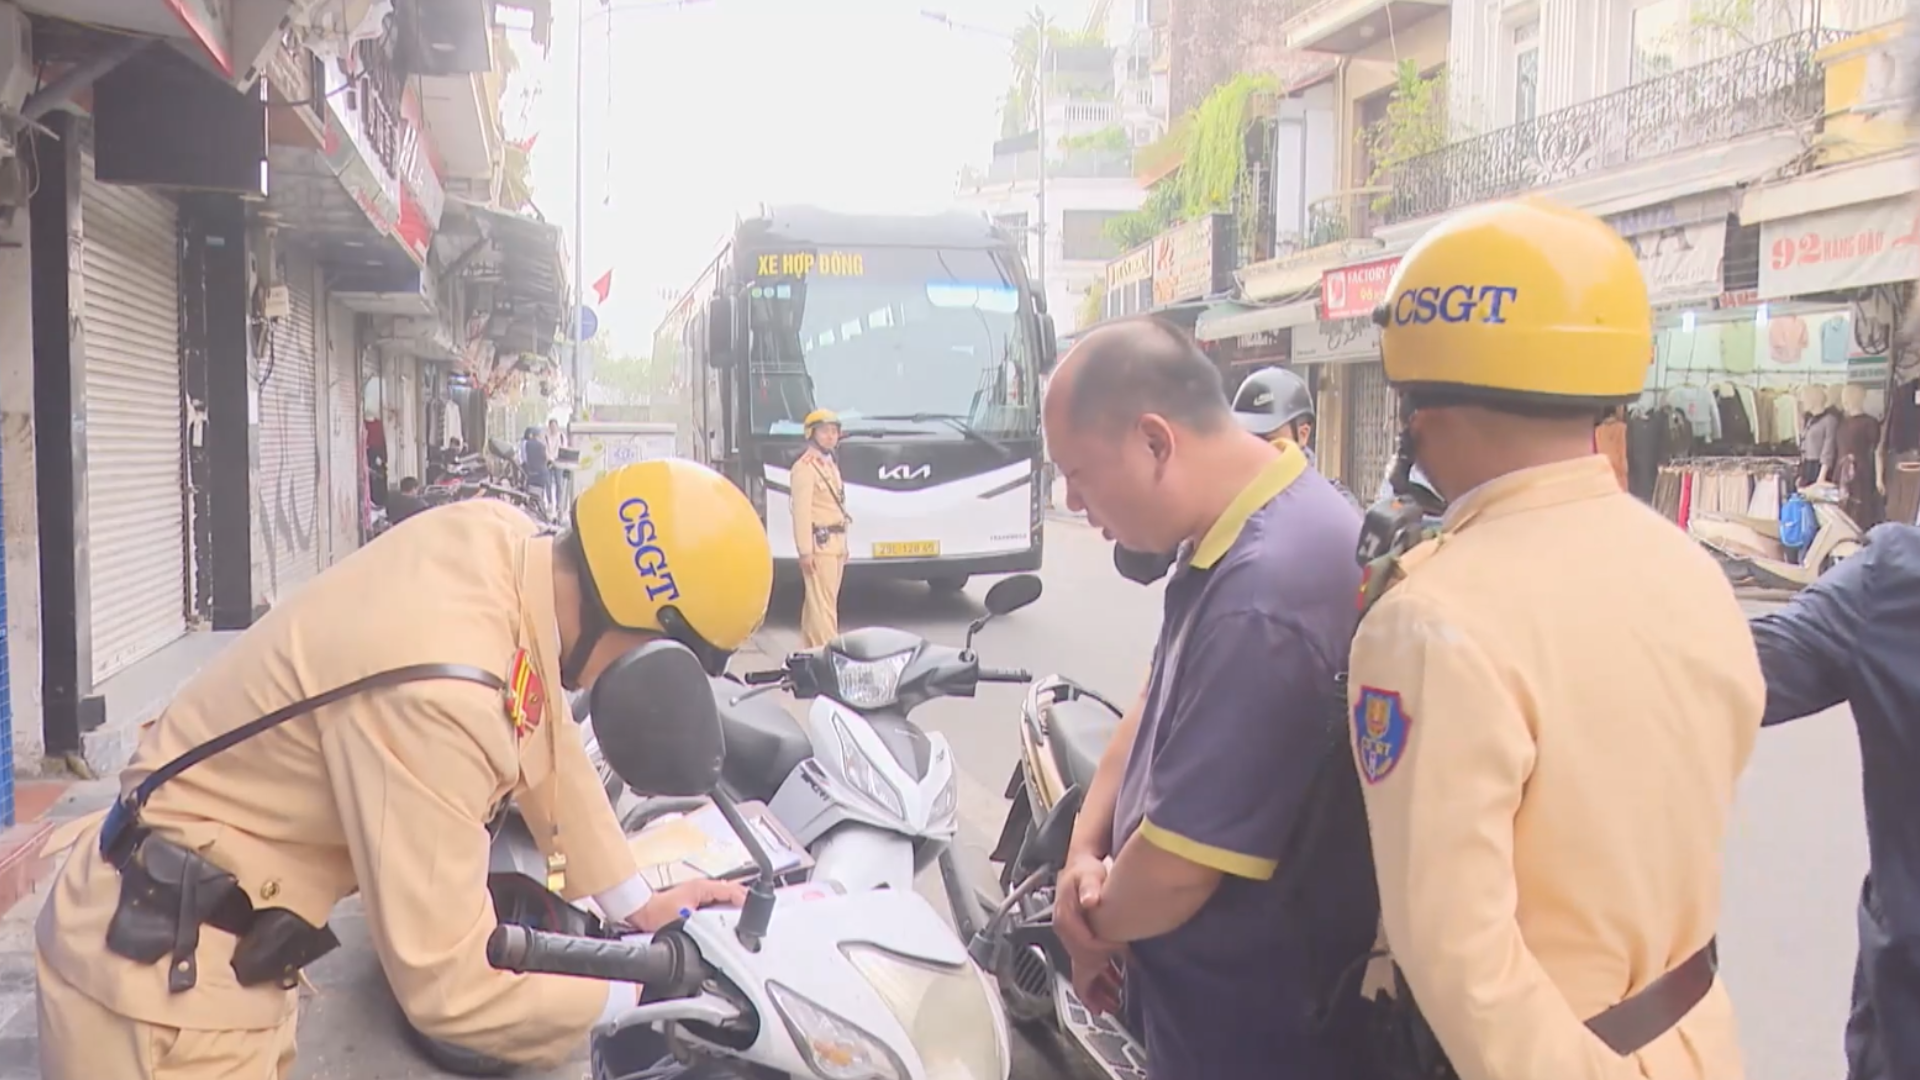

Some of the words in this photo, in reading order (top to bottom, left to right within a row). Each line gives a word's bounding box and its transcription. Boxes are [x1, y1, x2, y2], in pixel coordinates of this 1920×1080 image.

[758, 254, 779, 275] XE
[783, 251, 815, 278] HỢP
[819, 250, 863, 275] ĐỒNG
[1772, 233, 1821, 270] 92
[1347, 265, 1387, 284] FACTORY
[1394, 285, 1518, 327] CSGT
[878, 464, 931, 480] KIA
[618, 497, 681, 603] CSGT
